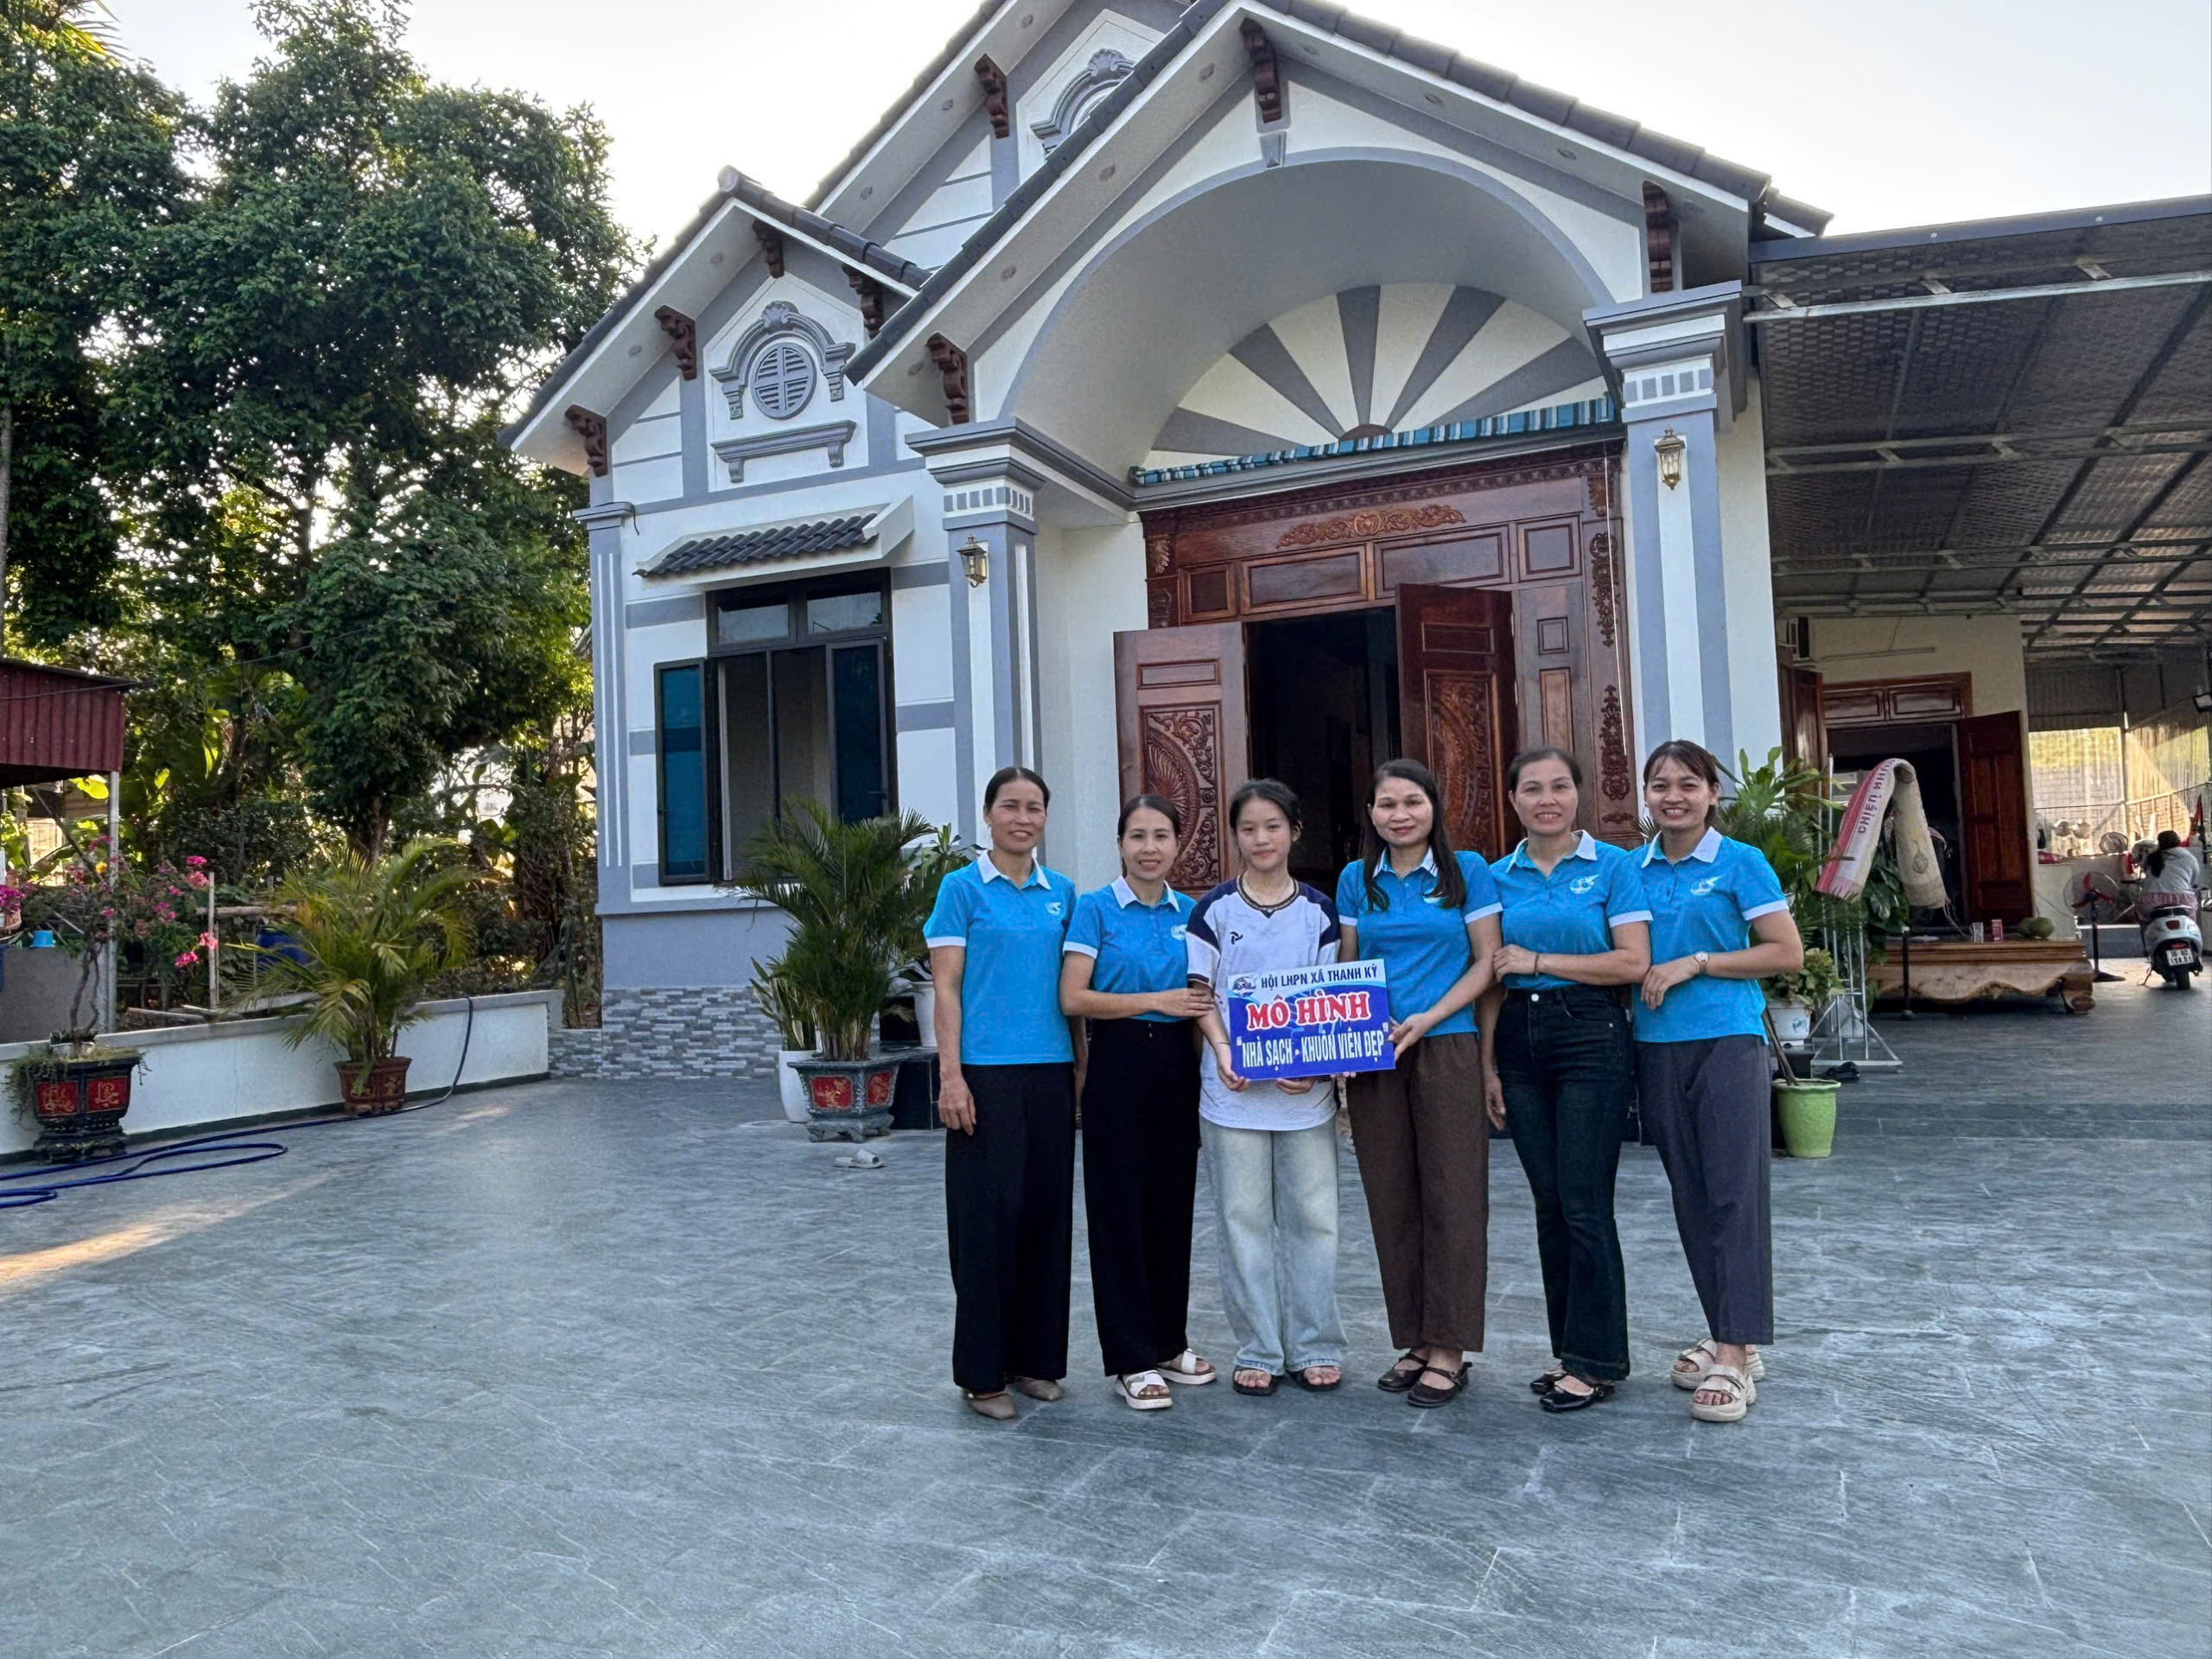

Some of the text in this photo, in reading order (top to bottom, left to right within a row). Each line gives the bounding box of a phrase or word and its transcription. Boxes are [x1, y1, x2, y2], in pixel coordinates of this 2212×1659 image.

[1262, 974, 1278, 991] HỘI
[1281, 974, 1308, 987] LHPN
[1327, 968, 1362, 982] THANH
[1247, 989, 1370, 1031] MÔ HÌNH
[1265, 1038, 1294, 1071] SẠCH
[1300, 1030, 1337, 1063] KHUÔN
[1338, 1027, 1363, 1059] VIÊN
